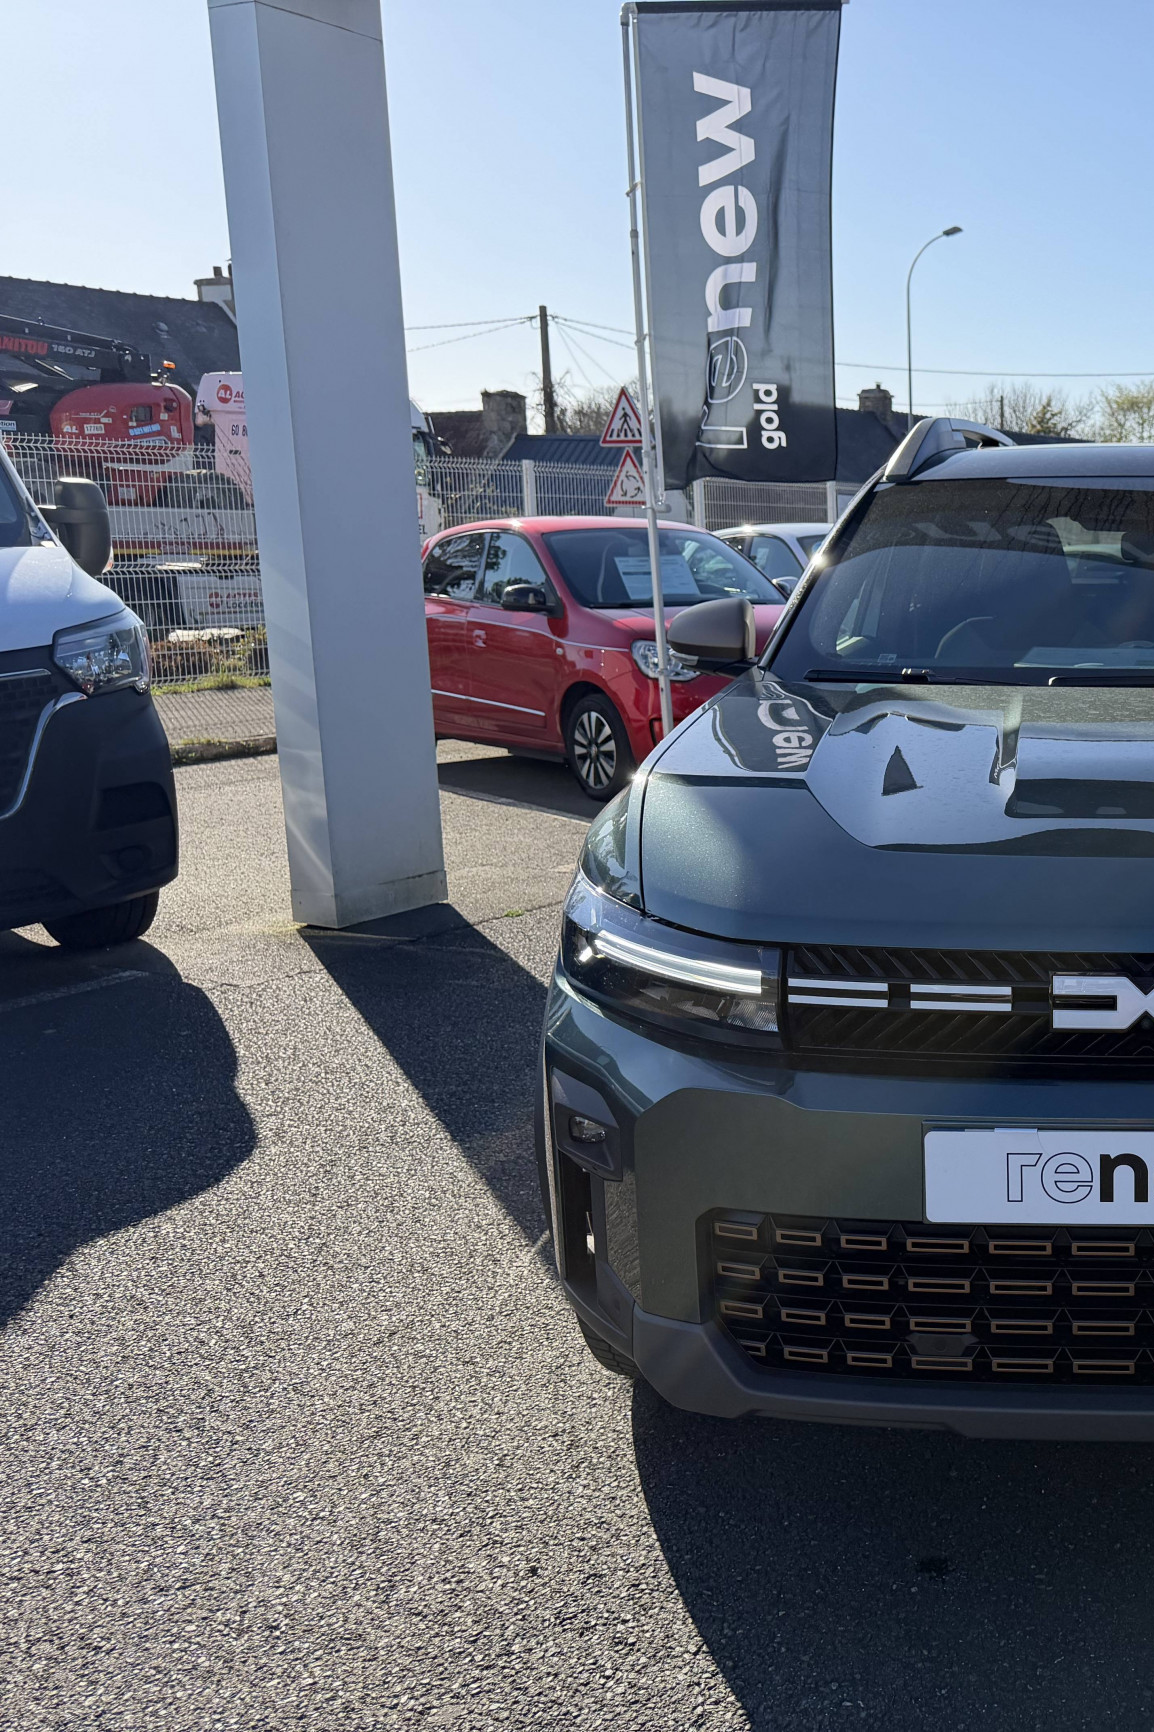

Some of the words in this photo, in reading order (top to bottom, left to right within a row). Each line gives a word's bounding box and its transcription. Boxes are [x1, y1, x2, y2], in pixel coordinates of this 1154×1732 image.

[693, 71, 758, 449] renew
[0, 335, 48, 355] NITOU
[753, 383, 786, 450] gold
